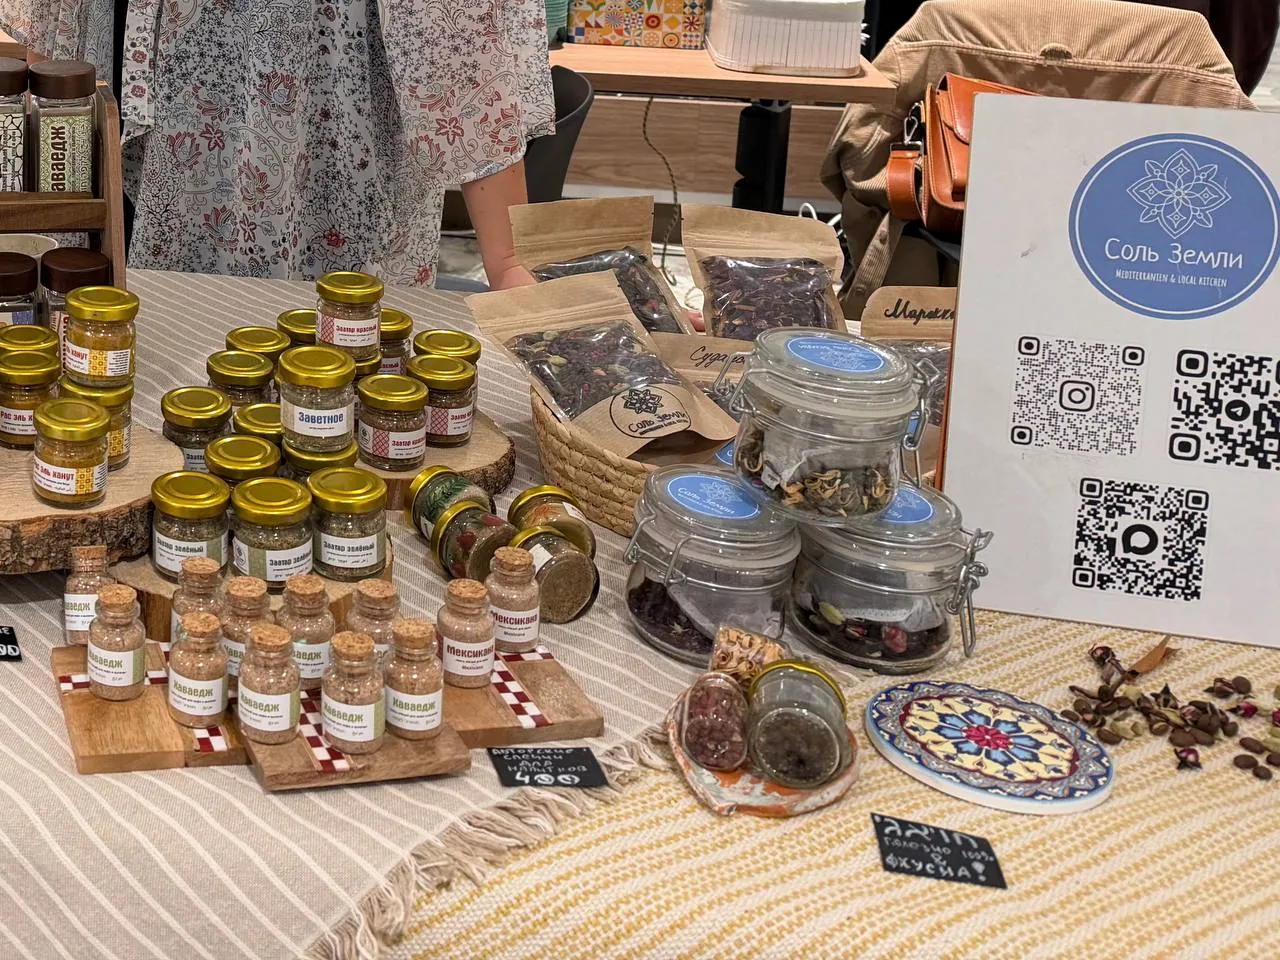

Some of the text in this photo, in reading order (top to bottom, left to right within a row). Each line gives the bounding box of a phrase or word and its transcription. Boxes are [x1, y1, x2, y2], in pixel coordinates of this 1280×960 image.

[50, 125, 67, 193] аваедж
[1104, 238, 1243, 269] Соль Земли
[298, 411, 344, 425] Заветное
[173, 679, 214, 698] Хаваедж
[392, 697, 436, 713] Хаваедж
[514, 771, 581, 784] 400
